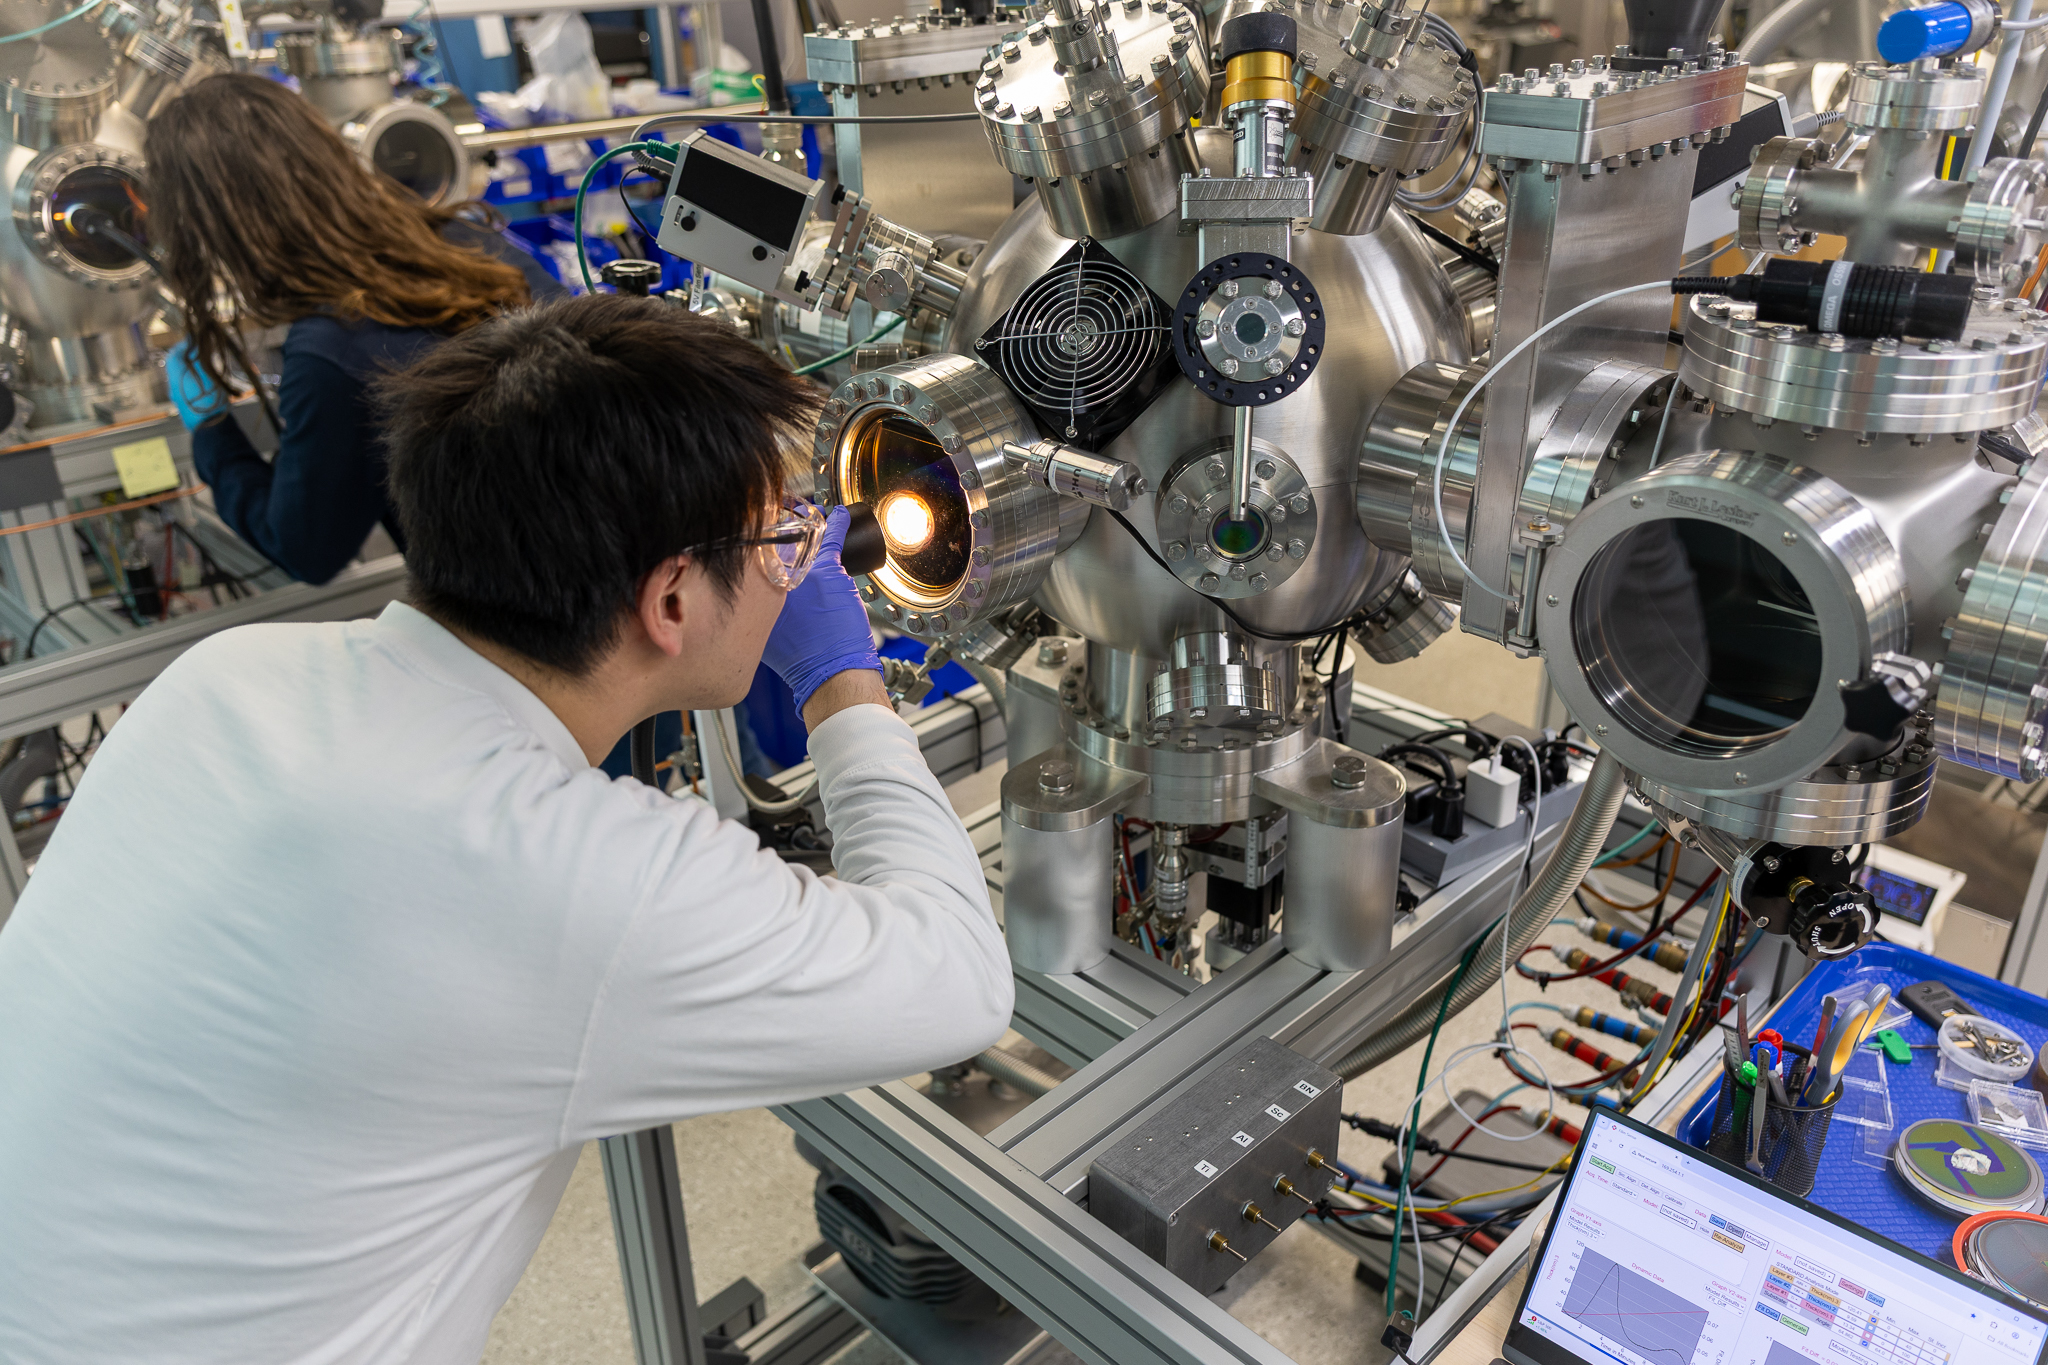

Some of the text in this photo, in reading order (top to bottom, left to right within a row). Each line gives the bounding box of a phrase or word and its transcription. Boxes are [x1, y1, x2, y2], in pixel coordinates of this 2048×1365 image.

[1668, 489, 1698, 509] Kurt
[1829, 903, 1855, 918] OPEN
[1811, 925, 1822, 947] SHUT
[1299, 1083, 1314, 1095] BN
[1271, 1107, 1284, 1118] Sc
[1236, 1135, 1249, 1144] Al
[1200, 1163, 1210, 1174] Ti
[1611, 1182, 1633, 1196] Standard
[1711, 1216, 1725, 1227] Save
[1727, 1224, 1742, 1237] Open
[1575, 1239, 1584, 1247] 120
[1713, 1232, 1743, 1251] Re-Analyze
[1745, 1233, 1766, 1248] Manage
[1630, 1261, 1665, 1283] Dynamic Data
[1771, 1267, 1784, 1277] Layer
[1807, 1264, 1826, 1277] saved)
[1768, 1274, 1782, 1285] Layer
[1775, 1260, 1839, 1296] STANDARD Analysis Mode
[1766, 1282, 1780, 1293] Layer
[1839, 1279, 1864, 1296] Settings
[1867, 1293, 1883, 1304] Save
[1764, 1308, 1778, 1318] Data
[1781, 1316, 1807, 1333] Generate
[1831, 1342, 1848, 1355] Model
